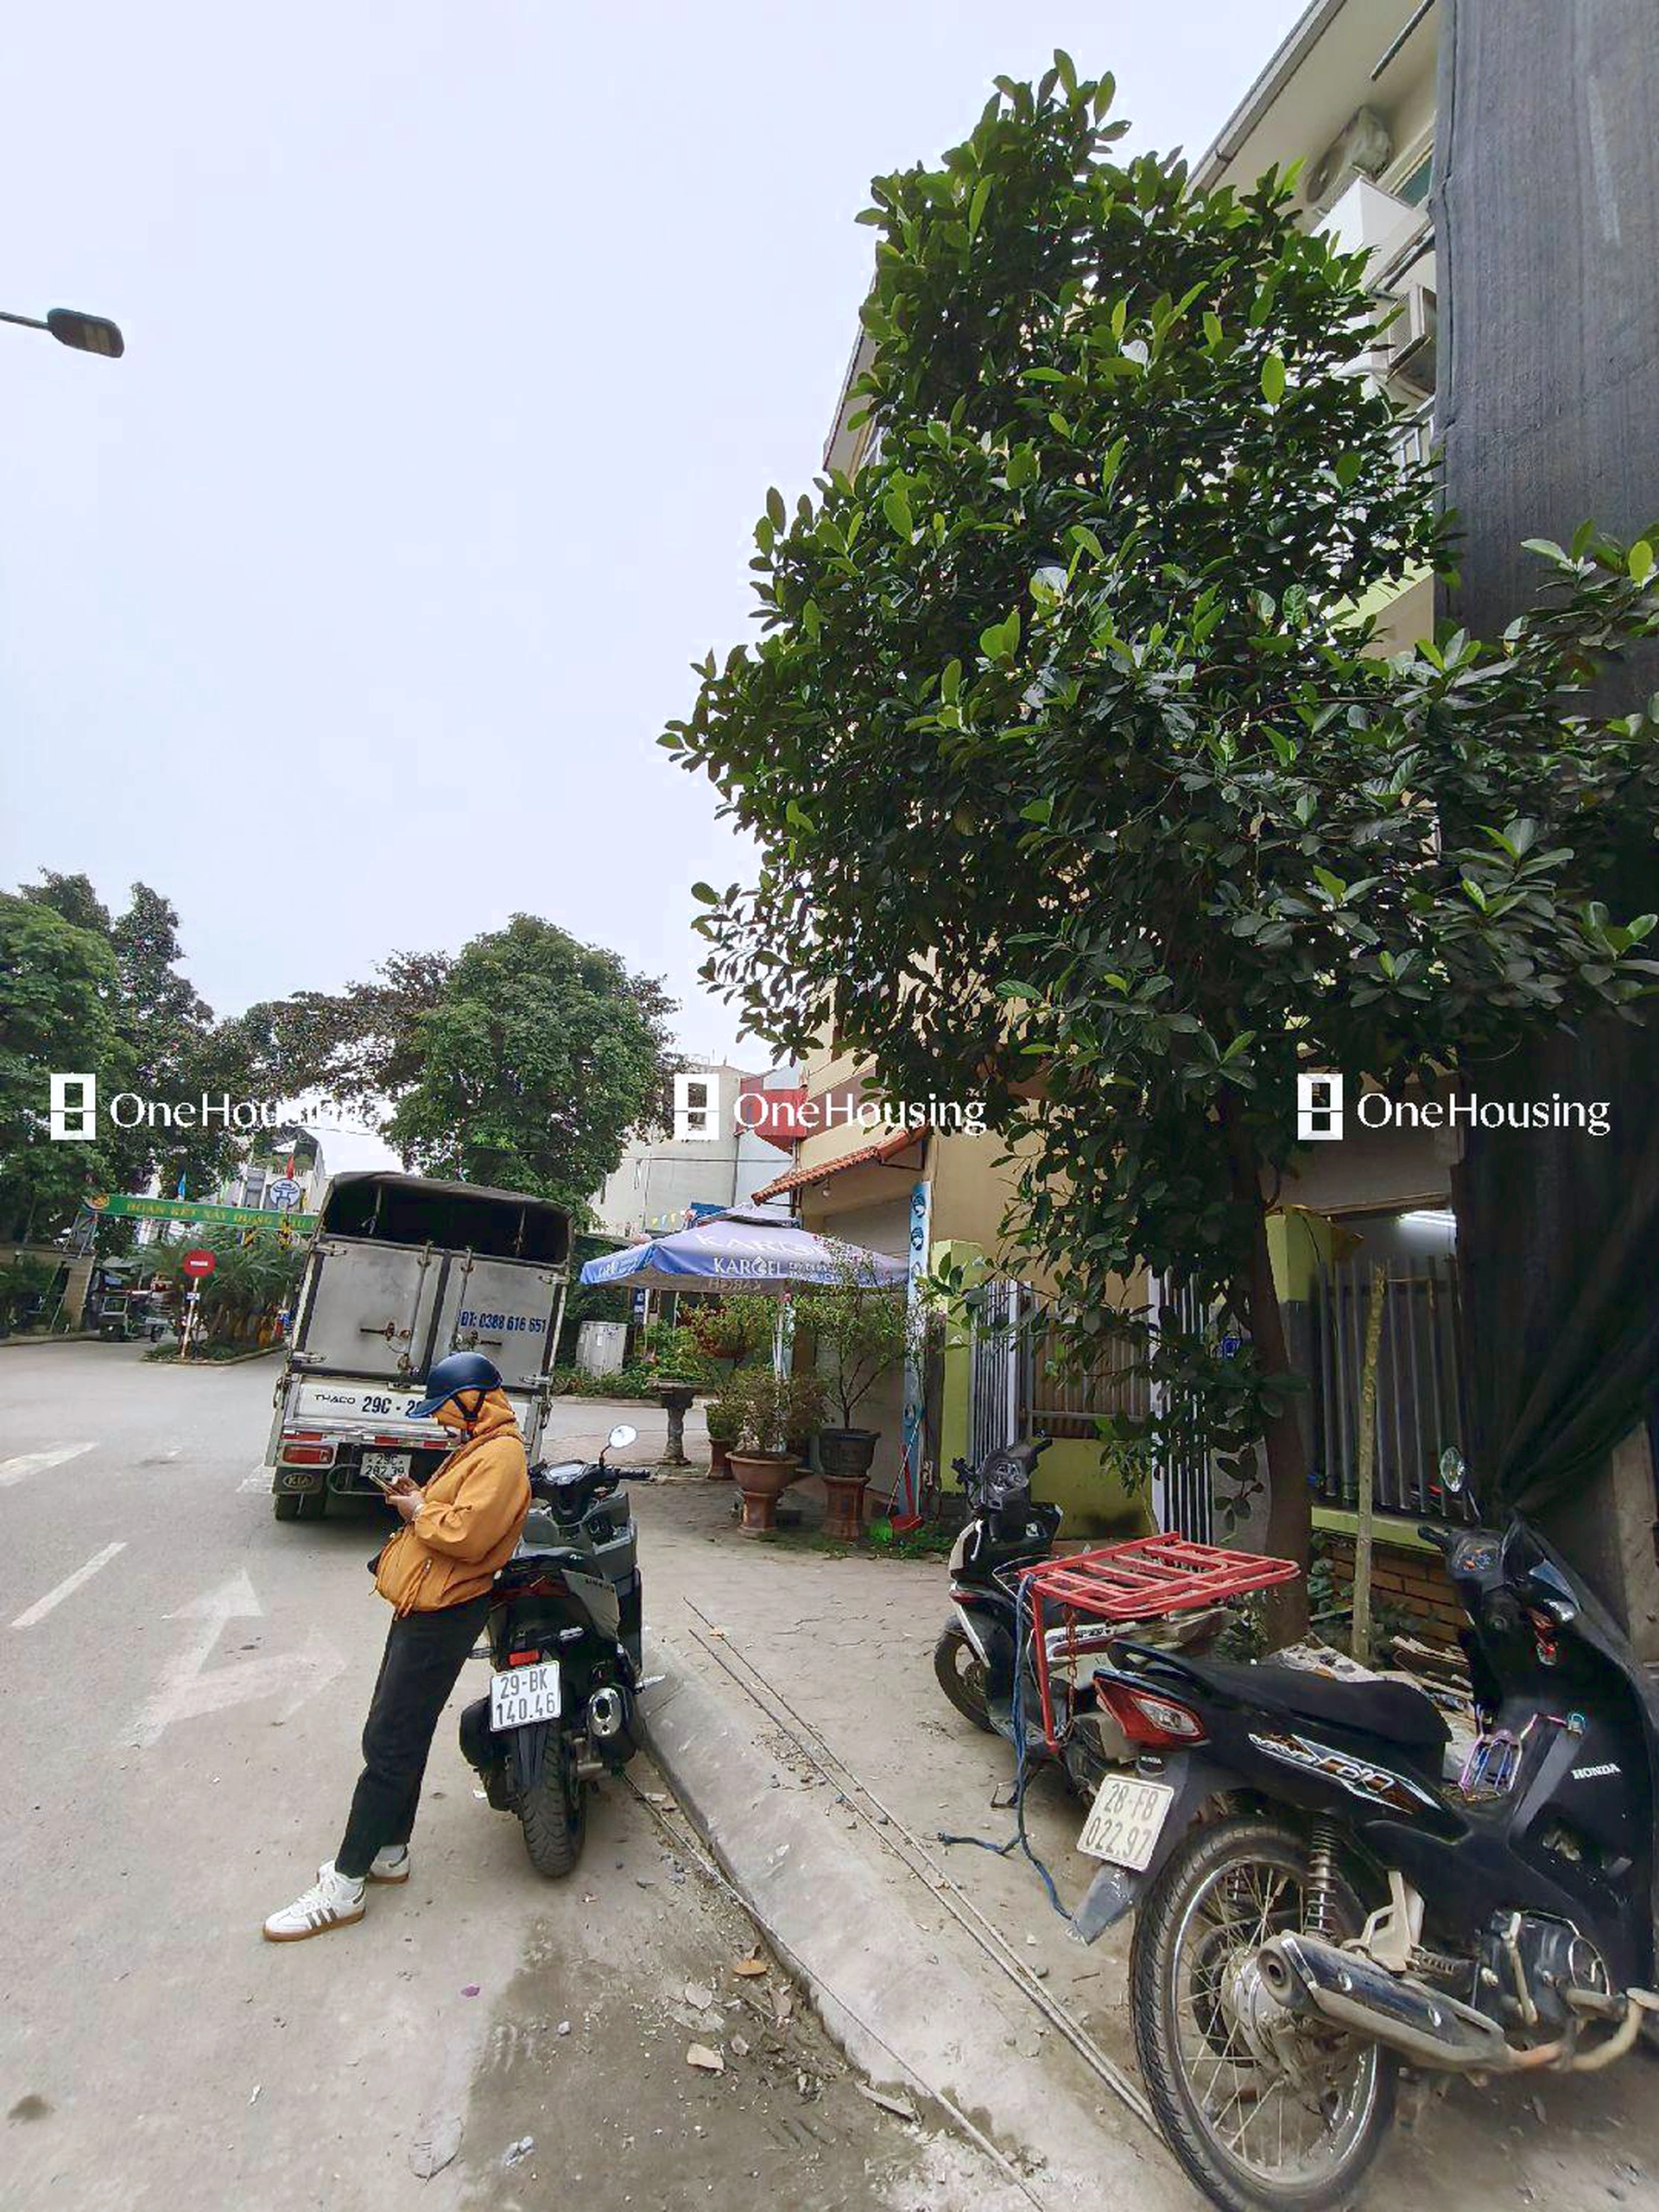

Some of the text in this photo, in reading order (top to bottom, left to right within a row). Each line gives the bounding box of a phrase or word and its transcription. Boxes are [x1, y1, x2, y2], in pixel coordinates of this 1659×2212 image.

[478, 1313, 505, 1330] 0388
[506, 1315, 526, 1331] 616
[314, 1394, 356, 1404] THACO
[362, 1396, 392, 1414] 29C
[500, 1668, 548, 1700] 29-BK
[496, 1693, 555, 1725] 140.46
[1571, 1763, 1622, 1779] HONDA
